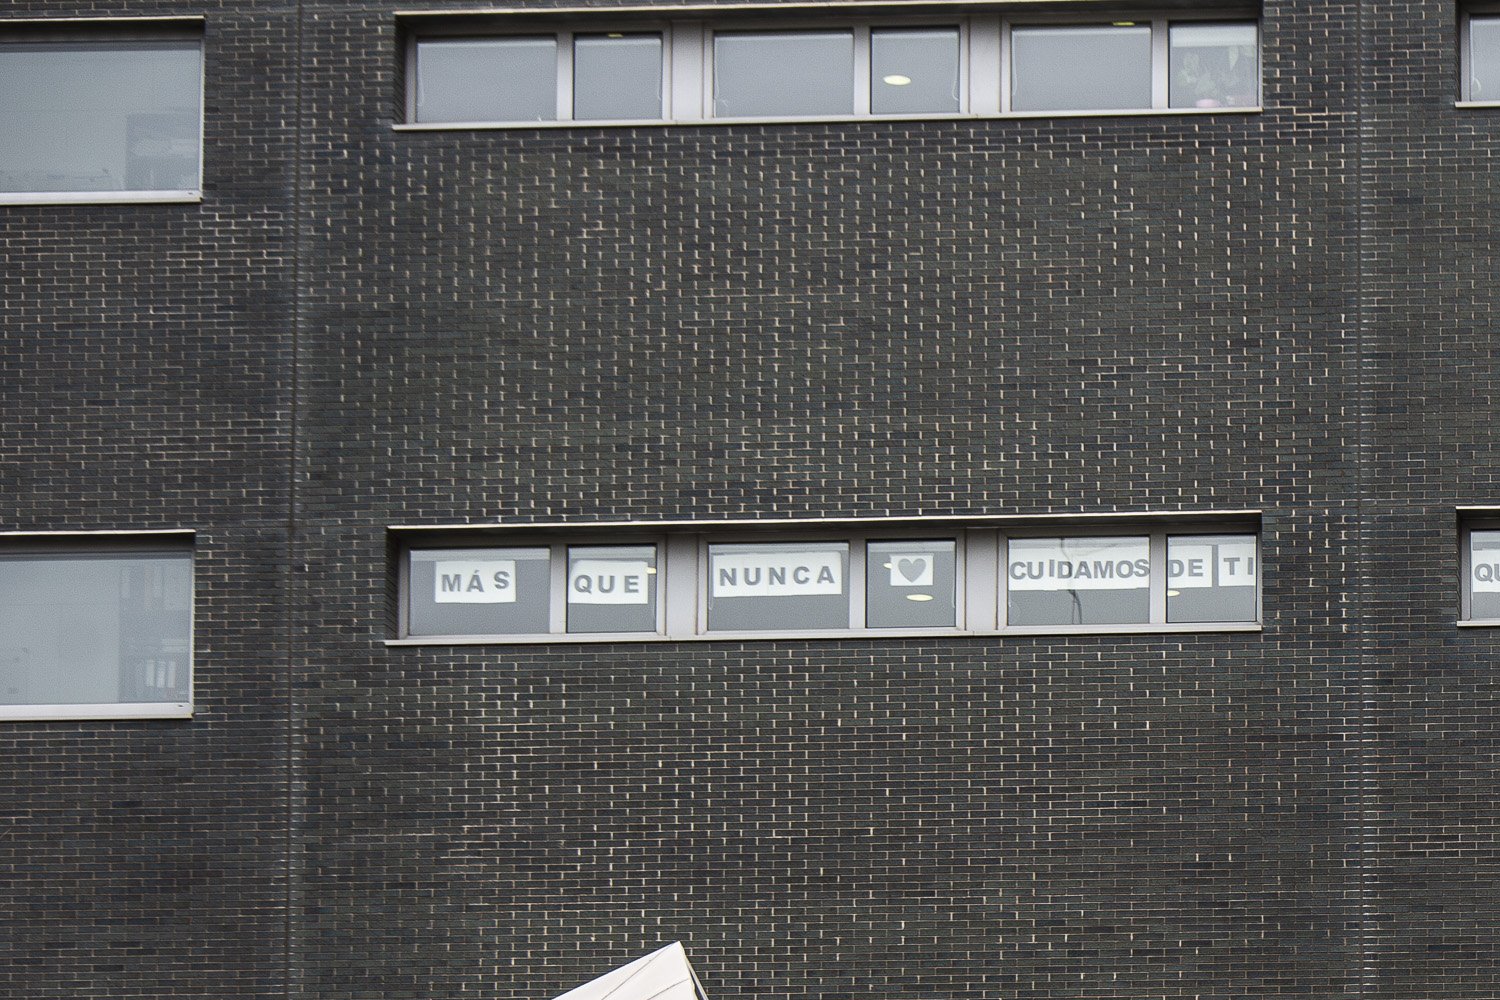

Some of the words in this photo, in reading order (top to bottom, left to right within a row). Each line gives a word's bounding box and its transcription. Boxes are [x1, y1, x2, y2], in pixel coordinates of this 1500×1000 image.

[441, 569, 511, 593] MÁS
[573, 573, 640, 595] QUE
[719, 565, 835, 587] NUNCA
[1009, 558, 1150, 580] CUIDAMOS
[1168, 558, 1203, 577] DE
[1223, 556, 1254, 576] TI
